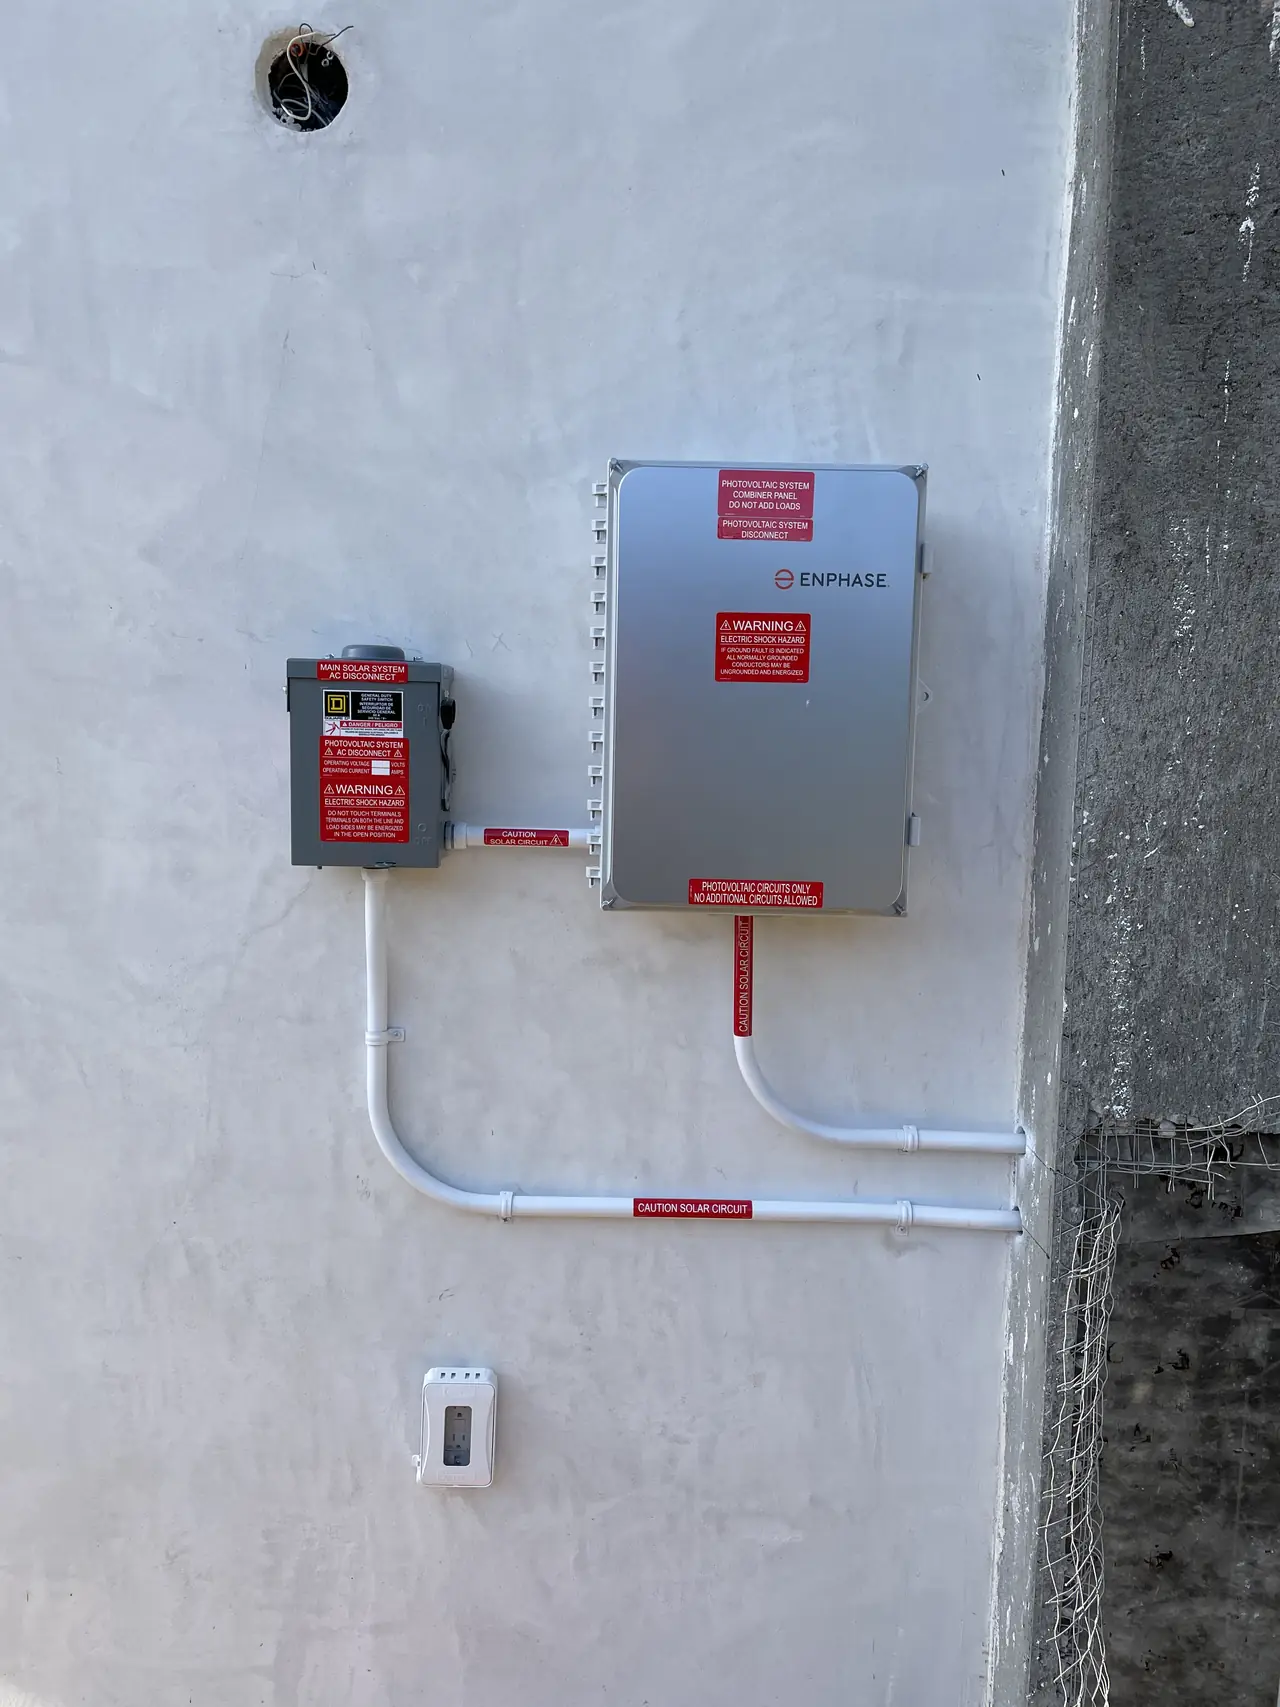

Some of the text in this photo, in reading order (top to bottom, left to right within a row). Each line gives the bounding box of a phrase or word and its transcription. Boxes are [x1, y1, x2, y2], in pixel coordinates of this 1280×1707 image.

[722, 480, 778, 489] PHOTOVOLTAIC
[733, 491, 772, 499] COMBINER
[722, 520, 777, 528] PHOTOVOLTAIC
[801, 573, 886, 587] ENPHASE
[733, 620, 794, 631] WARNING
[343, 672, 396, 680] DISCONNECT
[325, 740, 375, 748] PHOTOVOLTAIC
[336, 784, 393, 795] WARNING
[702, 881, 756, 892] PHOTOVOLTAIC
[757, 882, 790, 893] CIRCUITS
[792, 884, 811, 894] ONLY
[694, 893, 705, 902] NO
[706, 893, 748, 904] ADDITIONAL
[749, 894, 782, 904] CIRCUITS
[783, 895, 818, 906] ALLOWED
[739, 921, 748, 1032] CAUTION SOLAR CIRCUIT
[638, 1203, 748, 1213] CAUTION SOLAR CIRCUIT
